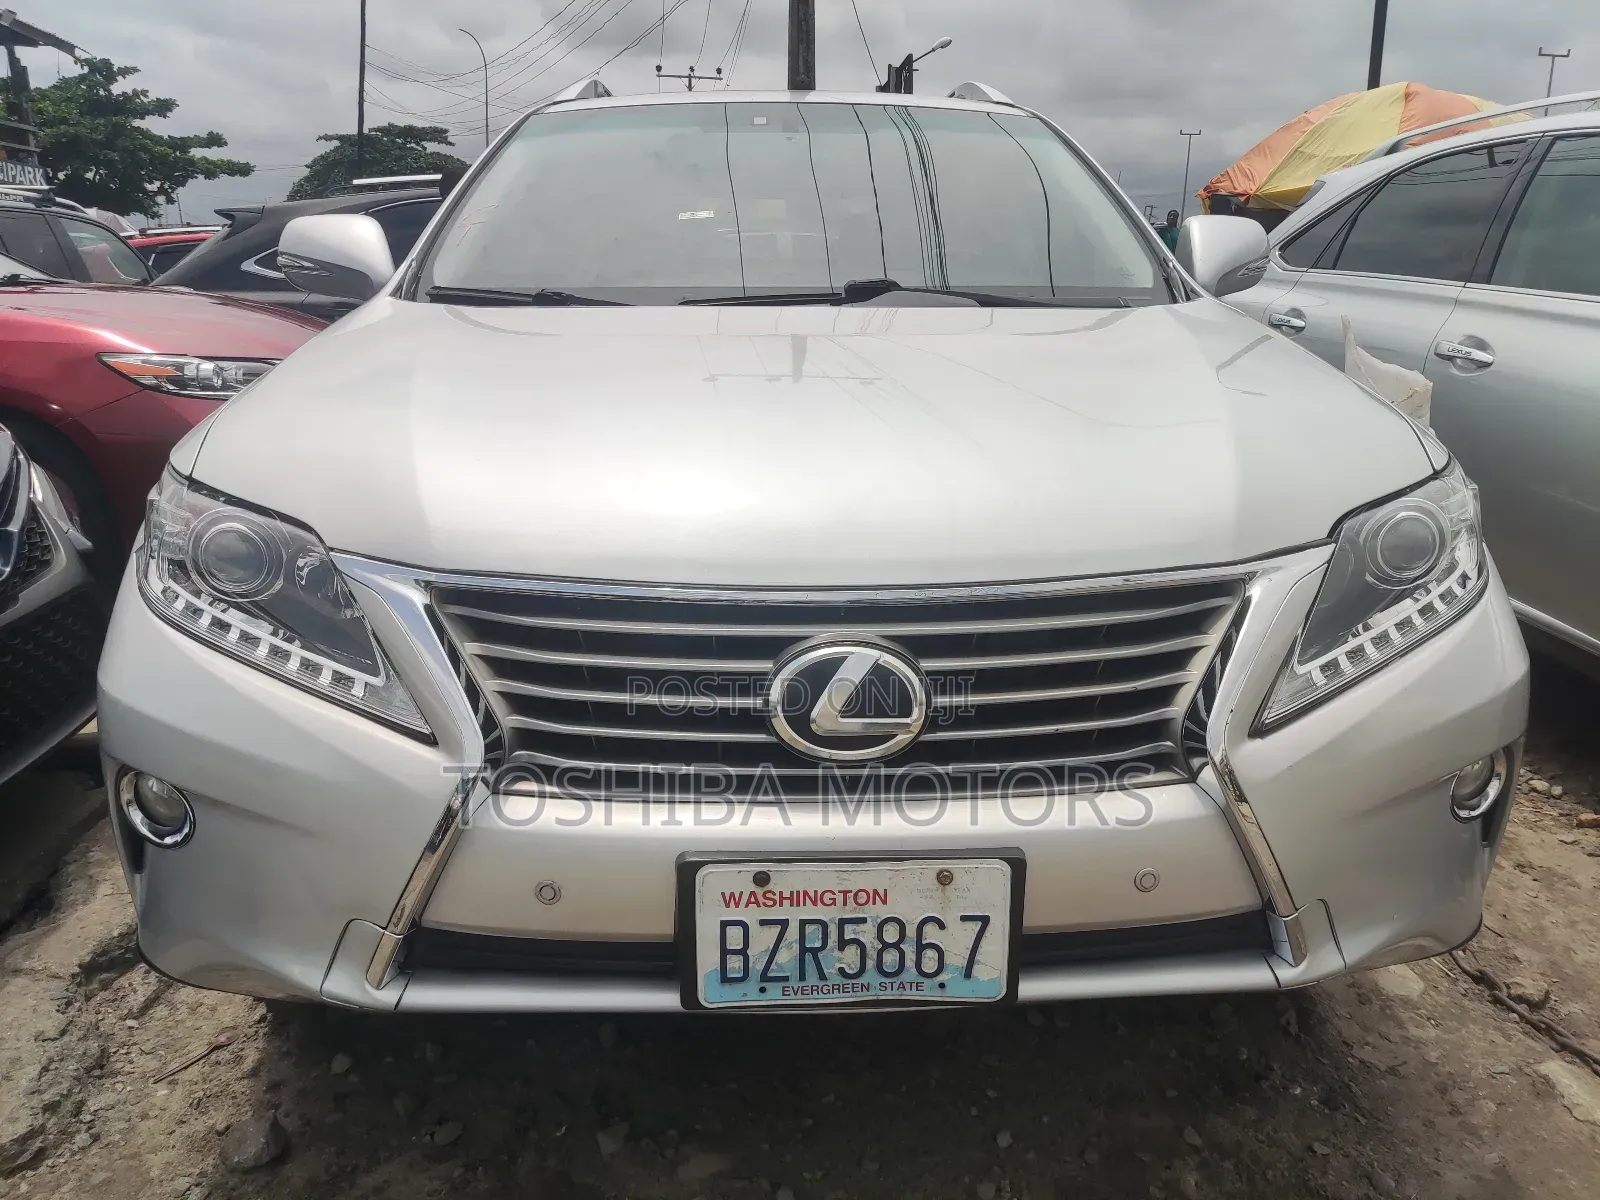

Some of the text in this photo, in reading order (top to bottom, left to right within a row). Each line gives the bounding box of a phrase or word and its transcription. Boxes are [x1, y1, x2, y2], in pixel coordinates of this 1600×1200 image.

[1447, 346, 1473, 357] LEXUS
[720, 888, 889, 909] WASHINGTON
[719, 914, 991, 984] BZR5867
[781, 981, 925, 998] EVERGREEN STATE
